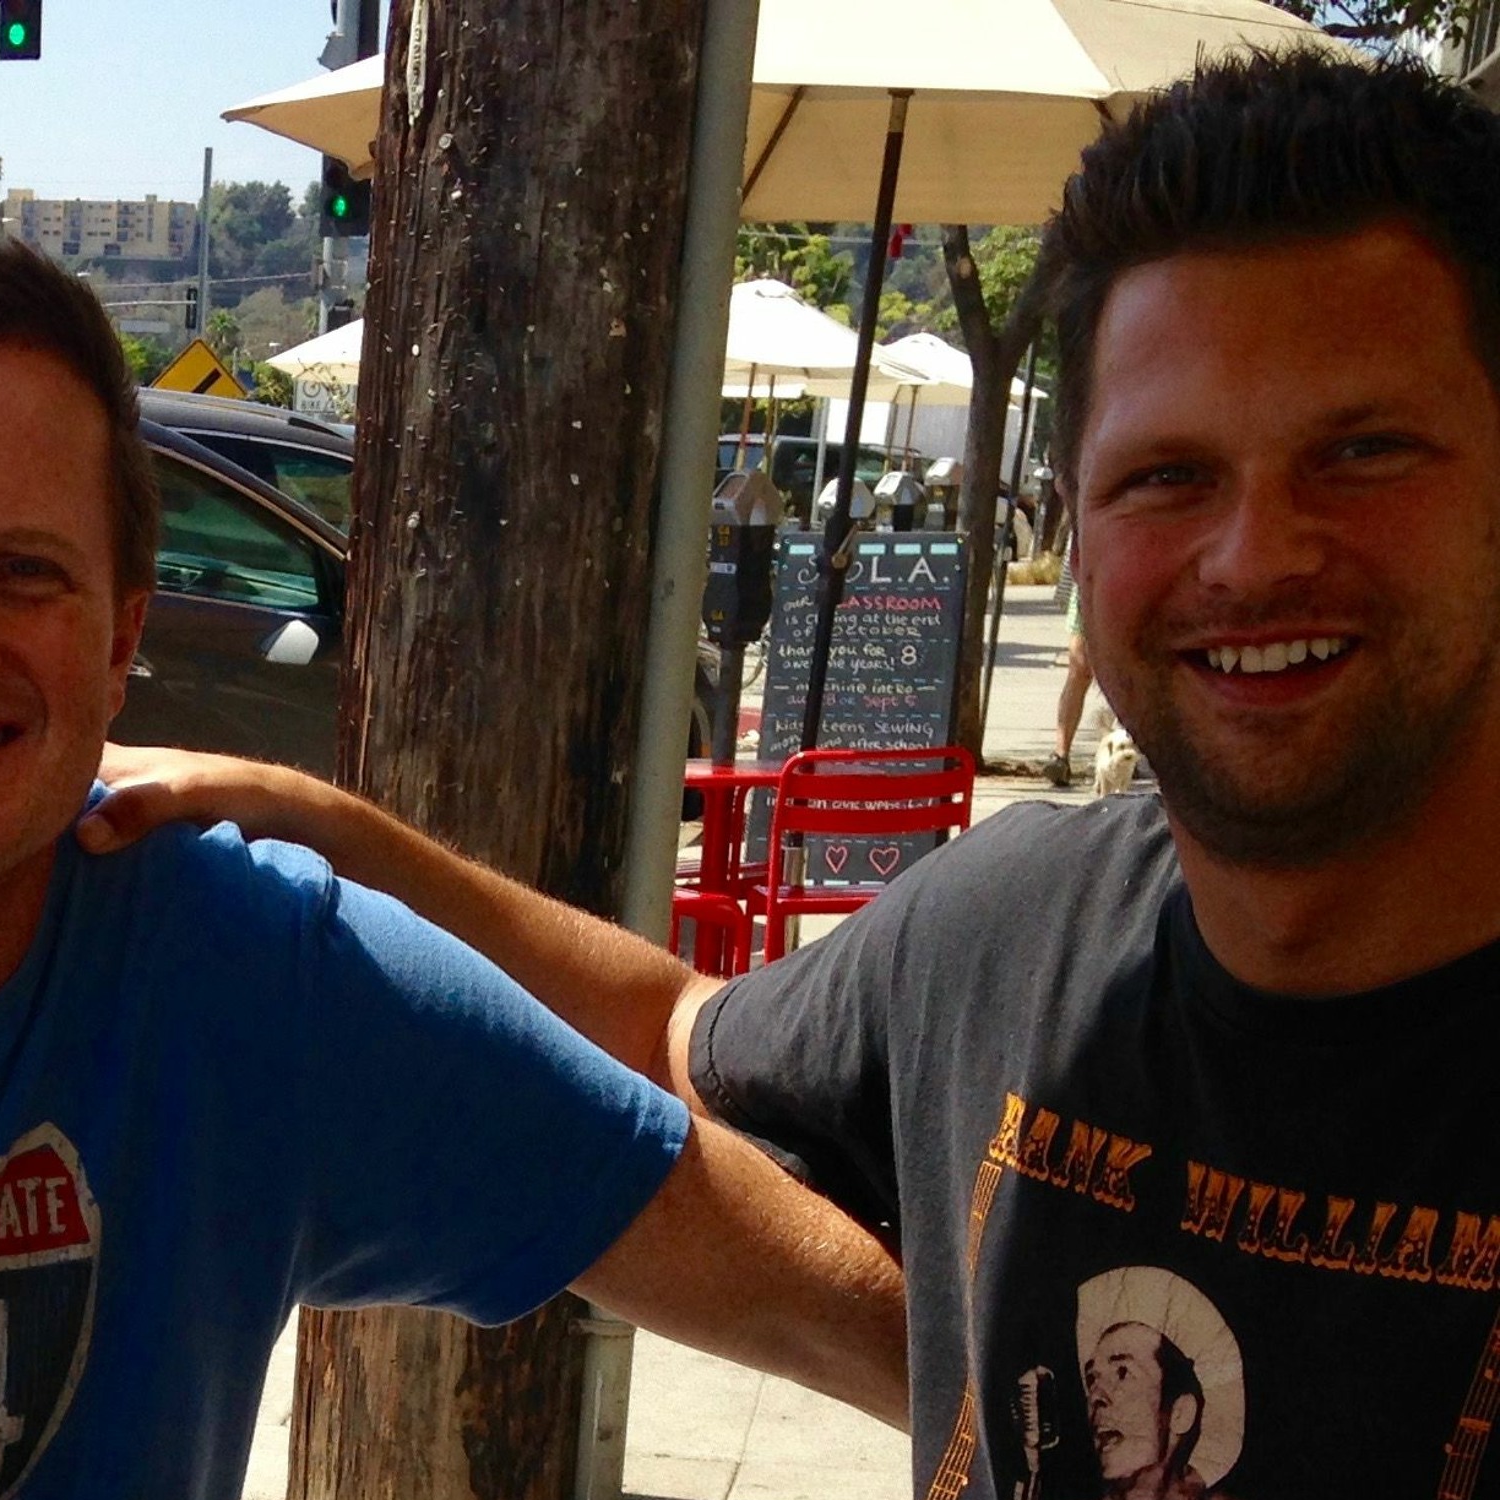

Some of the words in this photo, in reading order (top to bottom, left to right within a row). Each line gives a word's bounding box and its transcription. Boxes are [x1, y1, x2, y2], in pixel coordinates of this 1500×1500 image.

[778, 643, 814, 658] than
[828, 646, 857, 661] you
[900, 644, 917, 666] 8
[821, 719, 865, 734] teens
[1180, 1159, 1500, 1292] WILLIAM
